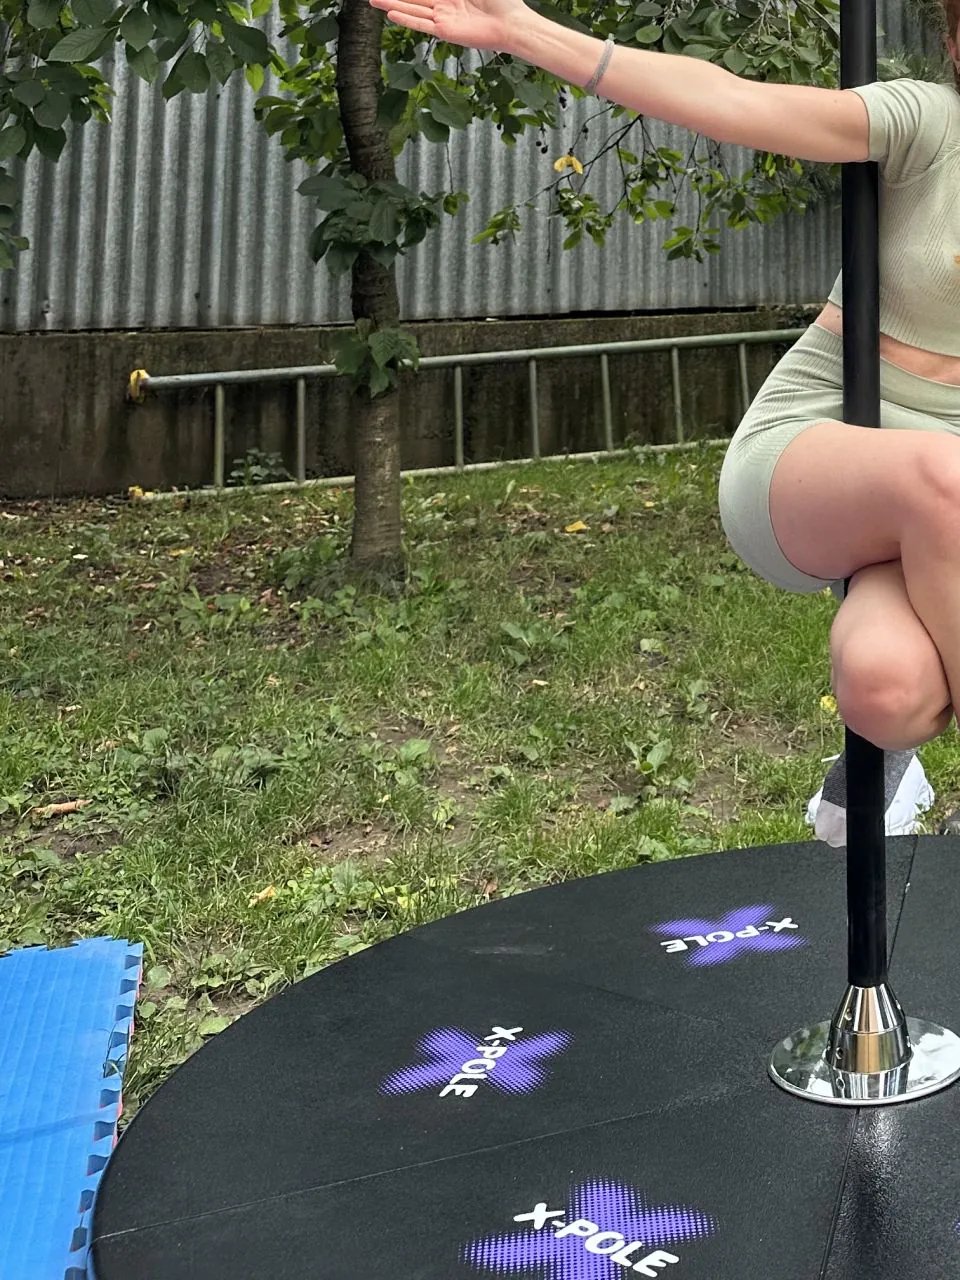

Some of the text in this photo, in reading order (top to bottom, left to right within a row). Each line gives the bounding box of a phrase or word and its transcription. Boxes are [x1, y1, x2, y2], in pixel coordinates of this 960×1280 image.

[660, 917, 799, 953] X-POLE
[438, 1026, 524, 1098] X-POLE
[513, 1202, 680, 1278] X-POLE
